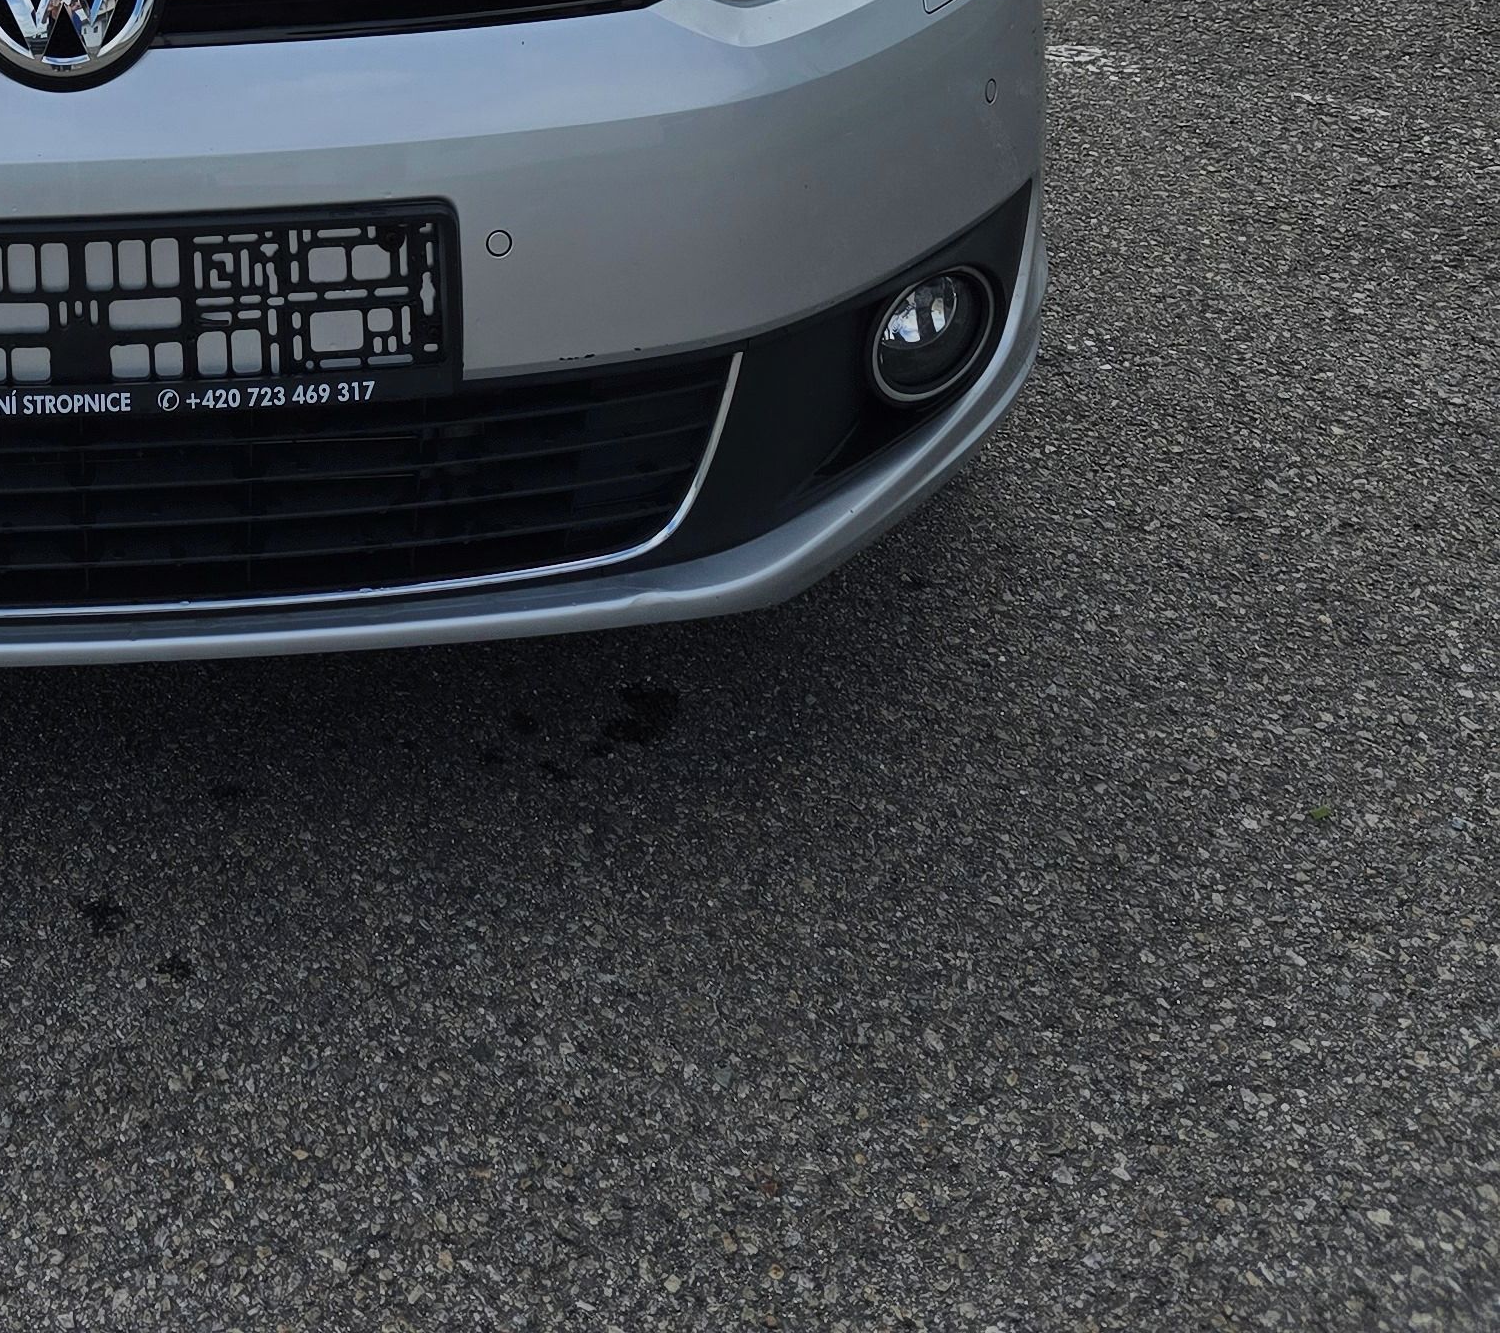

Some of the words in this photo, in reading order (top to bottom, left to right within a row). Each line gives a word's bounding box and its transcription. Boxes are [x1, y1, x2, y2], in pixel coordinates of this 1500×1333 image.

[22, 392, 132, 415] STROPNICE
[185, 388, 242, 410] +420
[247, 386, 286, 407] 723
[291, 383, 331, 405] 469
[337, 380, 376, 402] 317
